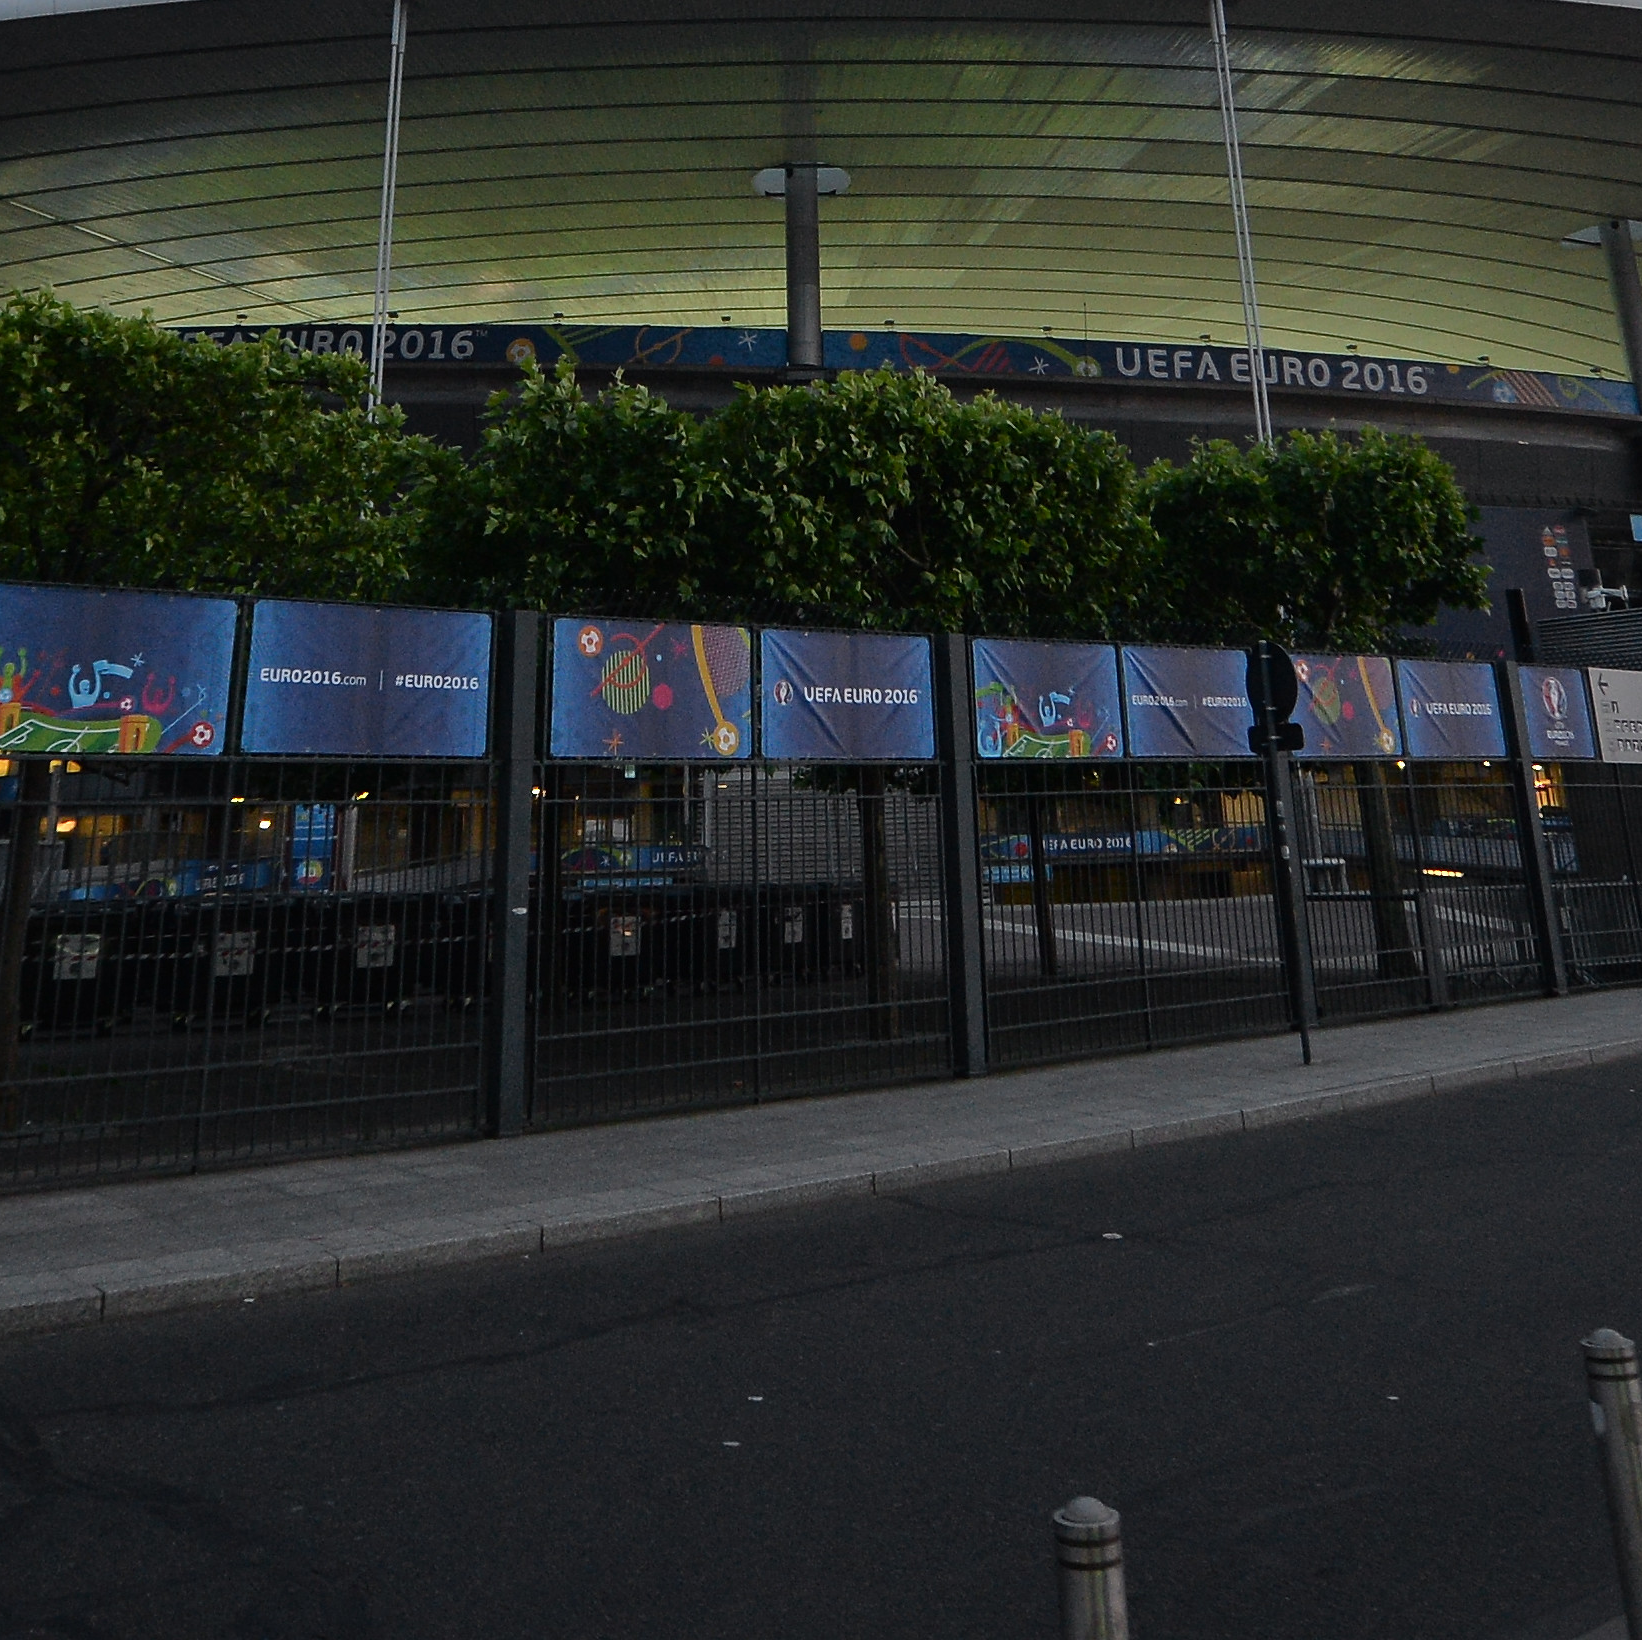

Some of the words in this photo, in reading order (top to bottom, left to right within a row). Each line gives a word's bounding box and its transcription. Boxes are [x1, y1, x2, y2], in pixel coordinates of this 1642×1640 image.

[376, 329, 475, 360] 2016
[1116, 347, 1221, 381] UEFA
[1230, 353, 1331, 387] EURO
[1342, 360, 1429, 395] 2016
[260, 667, 367, 686] EURO2016.com
[395, 674, 479, 690] #EURO2016
[803, 686, 842, 704] UEFA
[843, 687, 882, 704] EURO
[884, 688, 918, 705] 2016
[1425, 702, 1449, 715] UEFA
[1448, 702, 1472, 715] EURO
[1042, 839, 1068, 851] EFA
[1070, 838, 1102, 850] EURO
